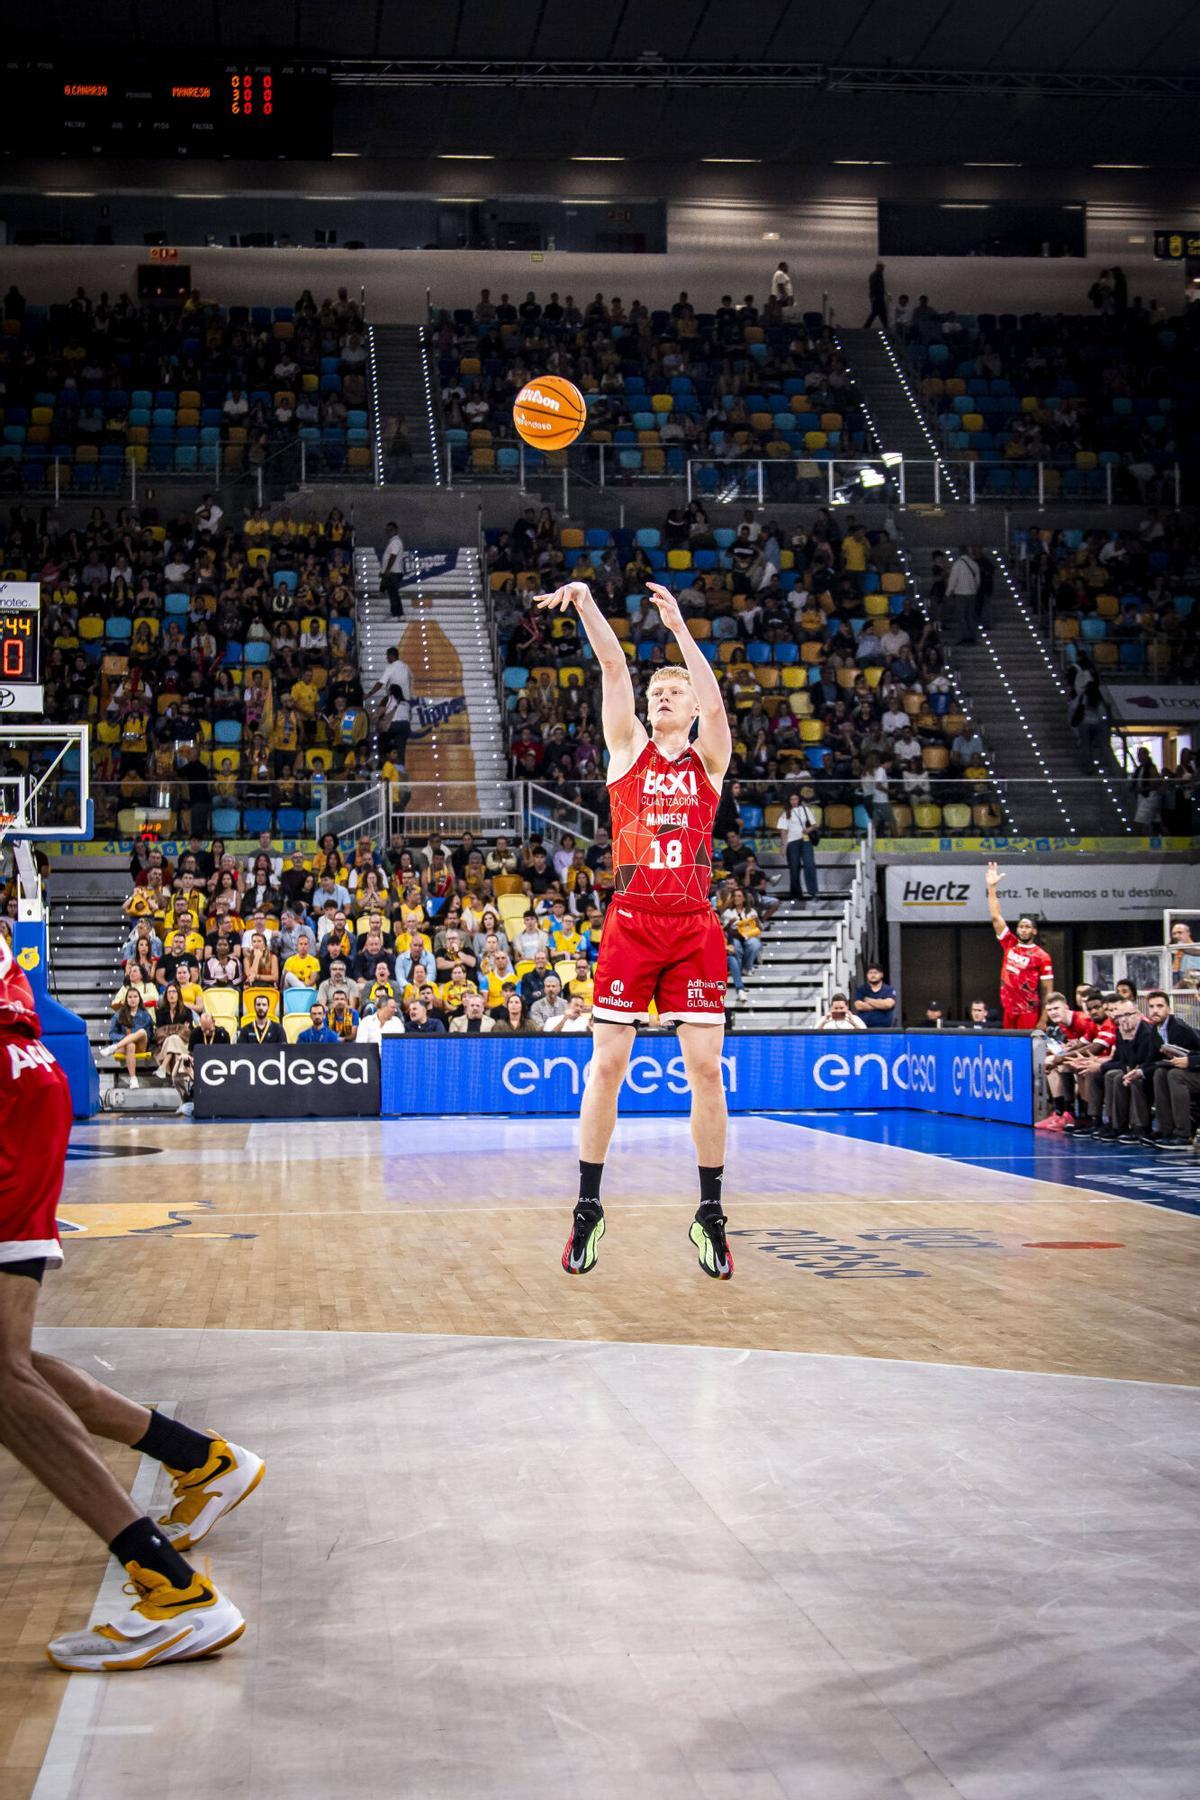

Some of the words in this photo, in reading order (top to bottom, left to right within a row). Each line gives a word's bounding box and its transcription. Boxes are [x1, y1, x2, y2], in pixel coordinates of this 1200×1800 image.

[243, 75, 253, 88] 0
[263, 75, 273, 88] 0
[232, 89, 240, 101] 3
[243, 89, 253, 101] 0
[263, 89, 273, 101] 0
[231, 102, 240, 114] 6
[243, 102, 253, 114] 0
[263, 102, 273, 115] 0
[643, 769, 698, 796] BAXI
[649, 840, 682, 869] 18
[903, 880, 970, 901] Hertz
[1026, 887, 1039, 899] Te
[1043, 887, 1097, 899] llevamos
[1101, 890, 1109, 899] a
[1112, 888, 1125, 899] tu
[598, 995, 634, 1008] unilabor
[687, 988, 705, 999] ETL
[687, 999, 720, 1009] GLOBAL
[200, 1051, 368, 1086] endesa
[952, 1044, 1014, 1102] endesa
[727, 1228, 932, 1280] endesa
